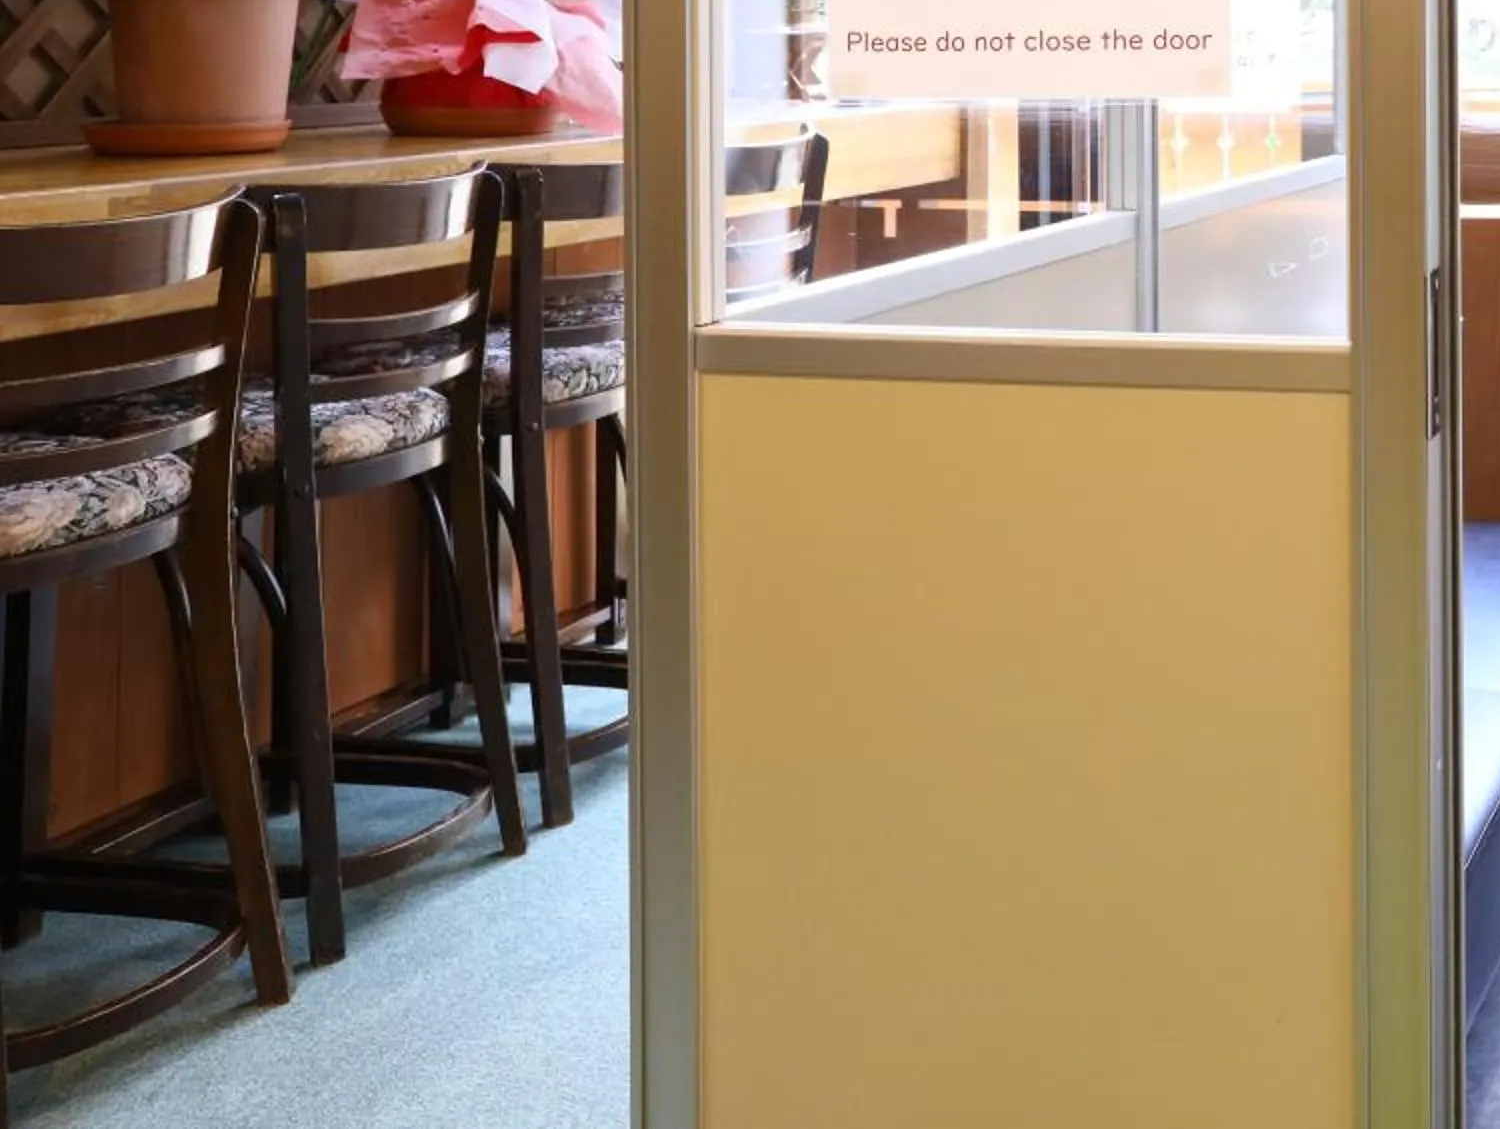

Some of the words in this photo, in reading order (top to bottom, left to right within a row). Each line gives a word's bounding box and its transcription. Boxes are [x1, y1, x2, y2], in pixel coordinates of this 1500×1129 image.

[847, 31, 927, 53] Please
[936, 30, 965, 52] do
[975, 32, 1016, 52] not
[1024, 29, 1091, 52] close
[1101, 28, 1144, 51] the
[1153, 28, 1213, 51] door
